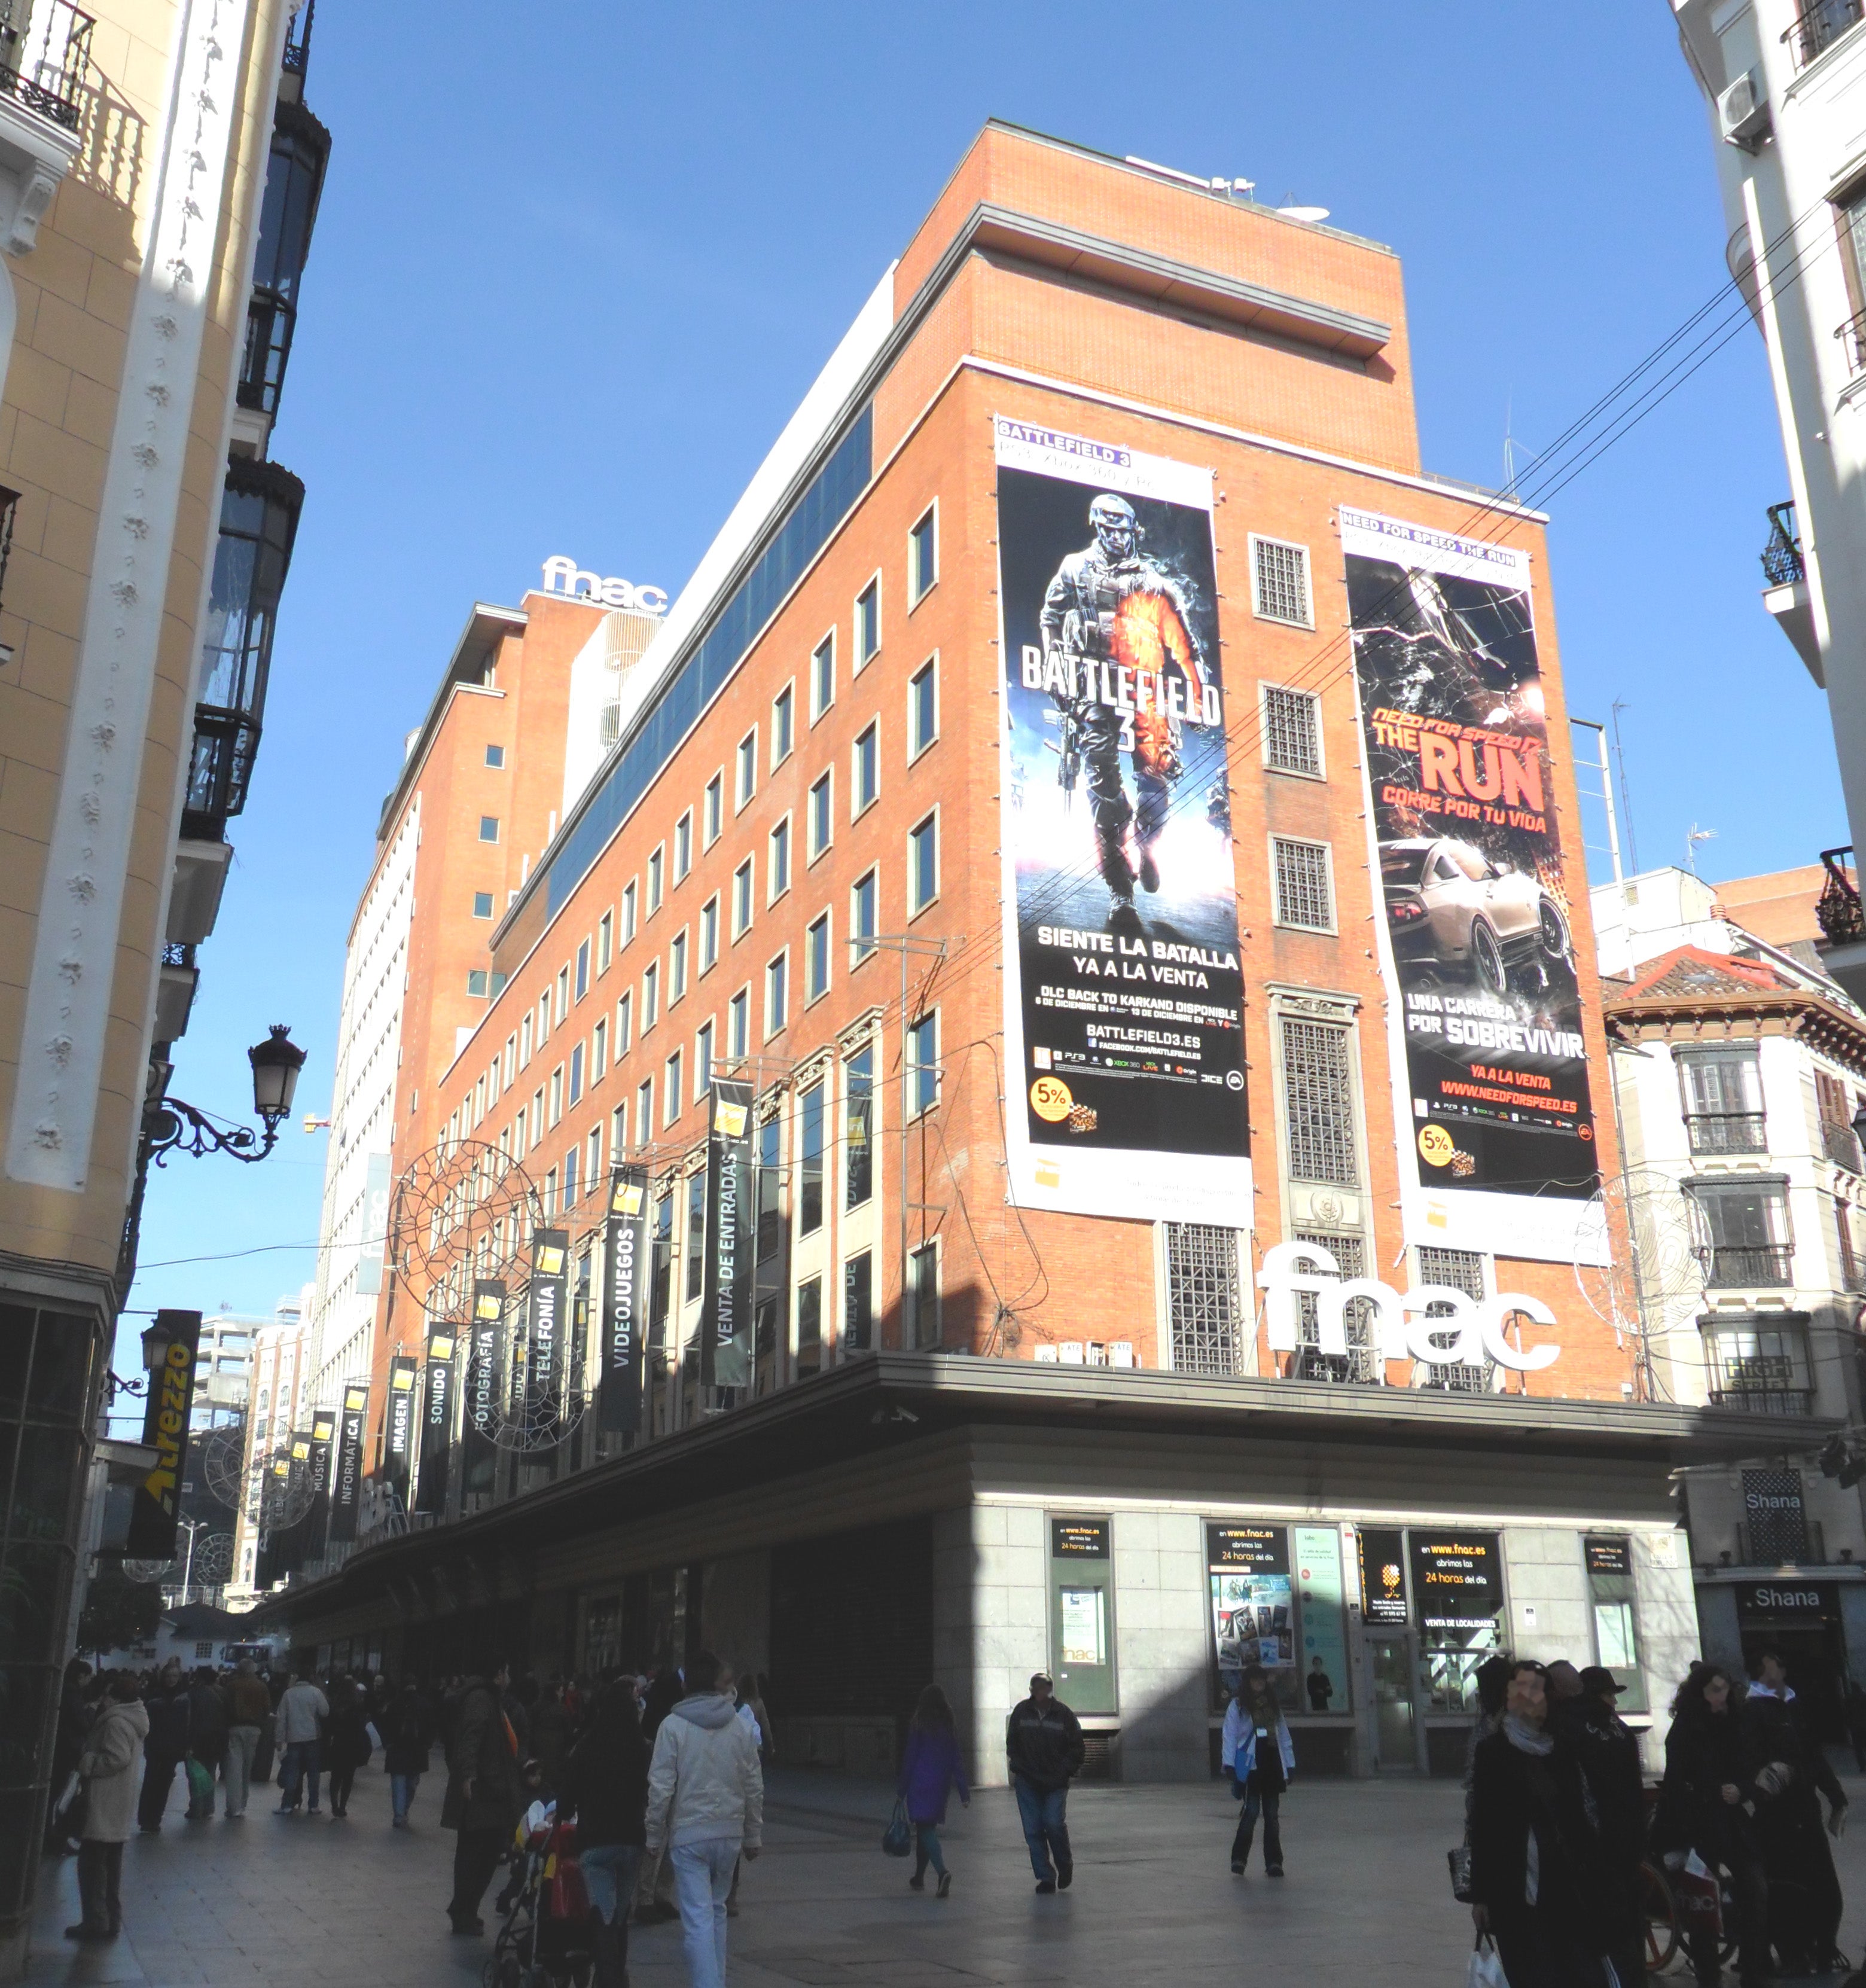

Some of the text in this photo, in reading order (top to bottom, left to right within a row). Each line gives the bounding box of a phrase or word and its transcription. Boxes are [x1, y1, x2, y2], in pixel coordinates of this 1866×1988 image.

[999, 422, 1130, 466] BATTLEFIELD 3
[1343, 513, 1515, 566] NEED FOR SPEED THE RUN
[542, 555, 668, 612] fnac
[1022, 645, 1221, 727] BATTLEFIELD
[1115, 708, 1135, 752] 3
[1372, 708, 1522, 749] NEED FOR SPEED
[1372, 721, 1544, 812] THE RUN
[1383, 786, 1547, 833] CORRE POR TU VIDA
[1038, 926, 1239, 971] SIENTE LA BATALLA
[1073, 956, 1209, 989] YA A LA VENTA
[1041, 986, 1237, 1020] DLC BACK TO KARKAND DISPONIBLE
[1055, 999, 1096, 1011] DICIEMBRE
[1154, 1011, 1193, 1022] DICIEMBRE
[1408, 993, 1517, 1021] UNA CARRERA
[1065, 1052, 1086, 1060] PS3
[1087, 1024, 1200, 1048] BATTLEFIELD3.ES
[1408, 1014, 1585, 1059] POR SOBREVIVIR
[1038, 1083, 1066, 1104] 5%
[1441, 1081, 1578, 1113] WWW.NEEDFORSPEED.ES
[1471, 1064, 1552, 1090] YA A LA VENTA
[1424, 1131, 1449, 1150] 5%
[717, 1153, 737, 1347] VENTA DE ENTRADAS
[614, 1228, 634, 1369] VIDEOJUEGOS
[1257, 1241, 1560, 1371] fnac
[536, 1286, 554, 1382] TELEFONÍA
[431, 1368, 446, 1425] SONIDO
[475, 1331, 493, 1431] FOTOGRAFÍA
[393, 1399, 407, 1452] IMAGEN
[342, 1419, 359, 1504] INFORMÁTICA
[1746, 1494, 1801, 1509] Shana
[1227, 1529, 1273, 1538] www.fnac.es
[1431, 1544, 1486, 1555] www.fnac.es
[1222, 1551, 1231, 1560] 24
[1233, 1551, 1254, 1560] horas
[1437, 1559, 1473, 1568] abrimos las
[1426, 1572, 1437, 1583] 24
[1438, 1572, 1463, 1583] horas
[1755, 1588, 1819, 1606] Shana
